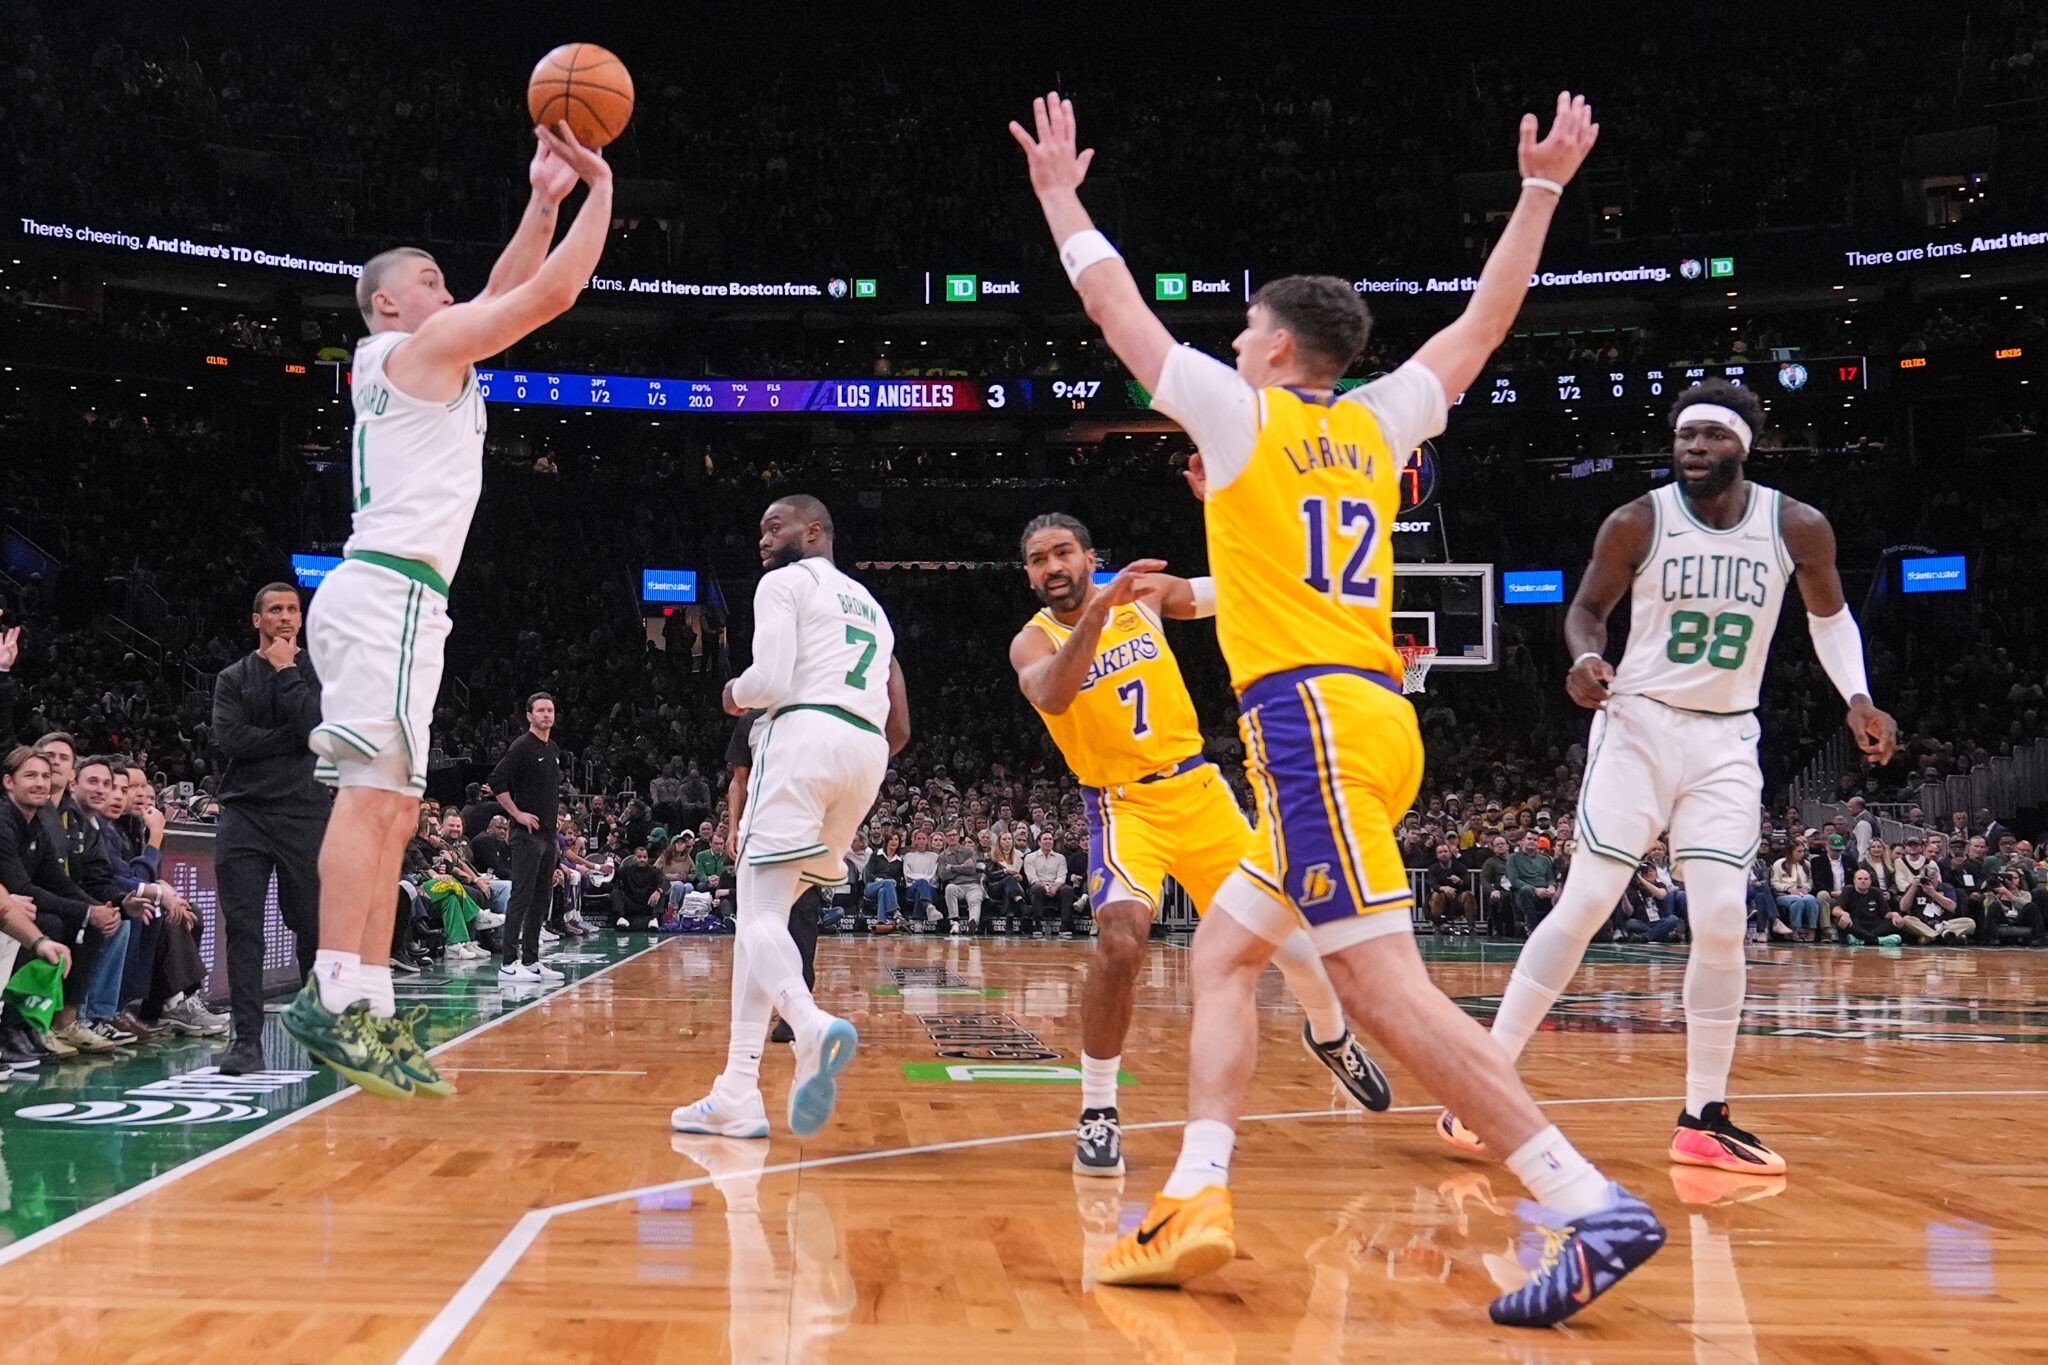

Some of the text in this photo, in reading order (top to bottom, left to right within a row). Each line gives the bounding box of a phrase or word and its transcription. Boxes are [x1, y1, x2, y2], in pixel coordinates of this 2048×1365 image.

[21, 218, 73, 239] There's
[76, 227, 144, 250] cheering.
[147, 235, 178, 252] And
[180, 240, 230, 259] there's
[231, 247, 251, 262] TD
[253, 250, 307, 270] Garden
[1846, 231, 2048, 267] There are fans. And ther
[592, 275, 626, 291] fans.
[629, 278, 659, 293] And
[661, 280, 700, 295] there
[702, 282, 727, 296] are
[729, 282, 784, 296] Boston
[785, 282, 822, 296] fans.
[948, 278, 1020, 298] TD Bank
[1158, 278, 1230, 296] TD Bank
[1354, 278, 1423, 295] cheering.
[1426, 278, 1458, 292] And
[1526, 273, 1540, 288] D
[1542, 269, 1604, 287] Garden
[1605, 266, 1671, 283] roaring.
[477, 373, 781, 392] AST STL TO 3PT FG FG% TOL FLS
[1496, 366, 1744, 387] FG 3PT TO STL AST REB
[1839, 367, 1857, 381] 17
[481, 386, 779, 408] 0 0 0 1/2 1/5 20.0 7 0
[837, 384, 1005, 408] LOS ANGELES 3
[1052, 381, 1101, 398] 9:47
[1491, 390, 1517, 404] 2/3
[1559, 387, 1581, 400] 1/2
[1612, 385, 1623, 397] 0
[1651, 383, 1662, 395] 0
[1072, 400, 1085, 410] 1st
[1392, 521, 1431, 532] SSOT
[1300, 494, 1380, 608] 12
[1663, 554, 1768, 608] CELTICS
[837, 593, 877, 627] BROWN
[1667, 610, 1754, 670] 88
[844, 624, 877, 691] 7
[1116, 676, 1153, 741] 7
